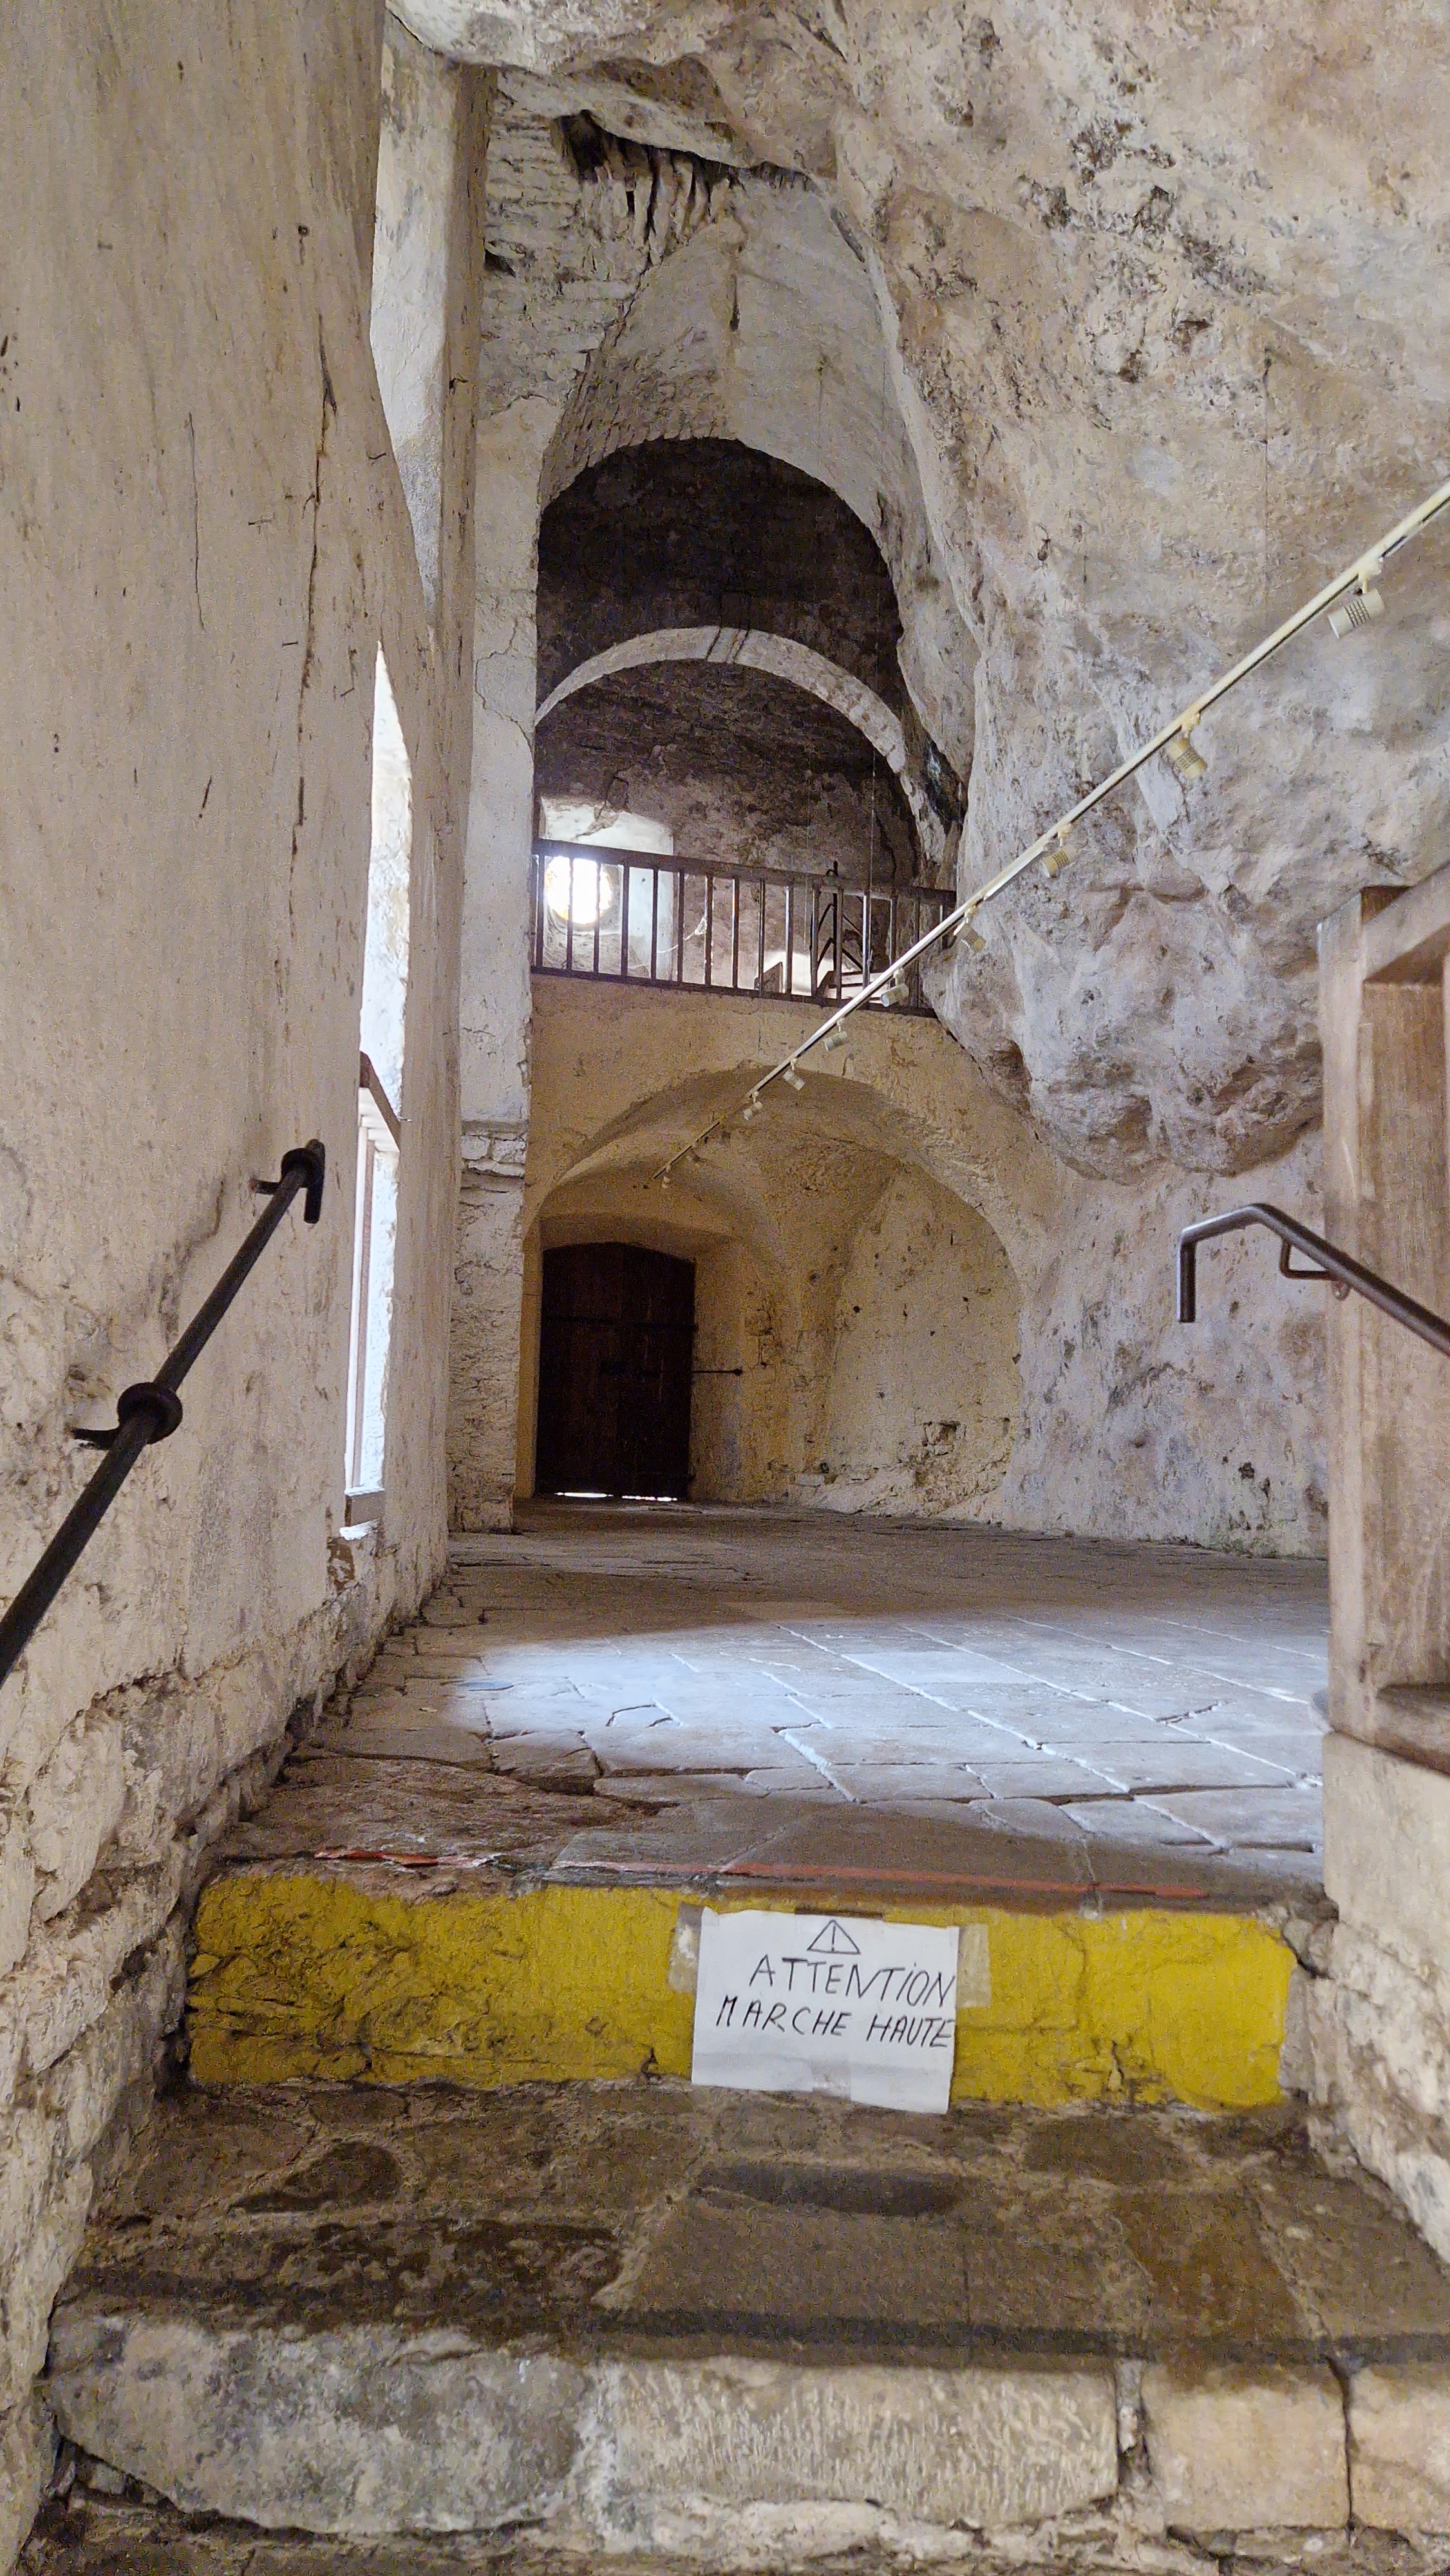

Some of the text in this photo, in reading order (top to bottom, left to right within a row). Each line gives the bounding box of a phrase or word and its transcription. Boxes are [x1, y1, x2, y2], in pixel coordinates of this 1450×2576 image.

[749, 1954, 956, 2008] ATTENTION
[715, 1994, 956, 2048] MARCHE HAUTE
